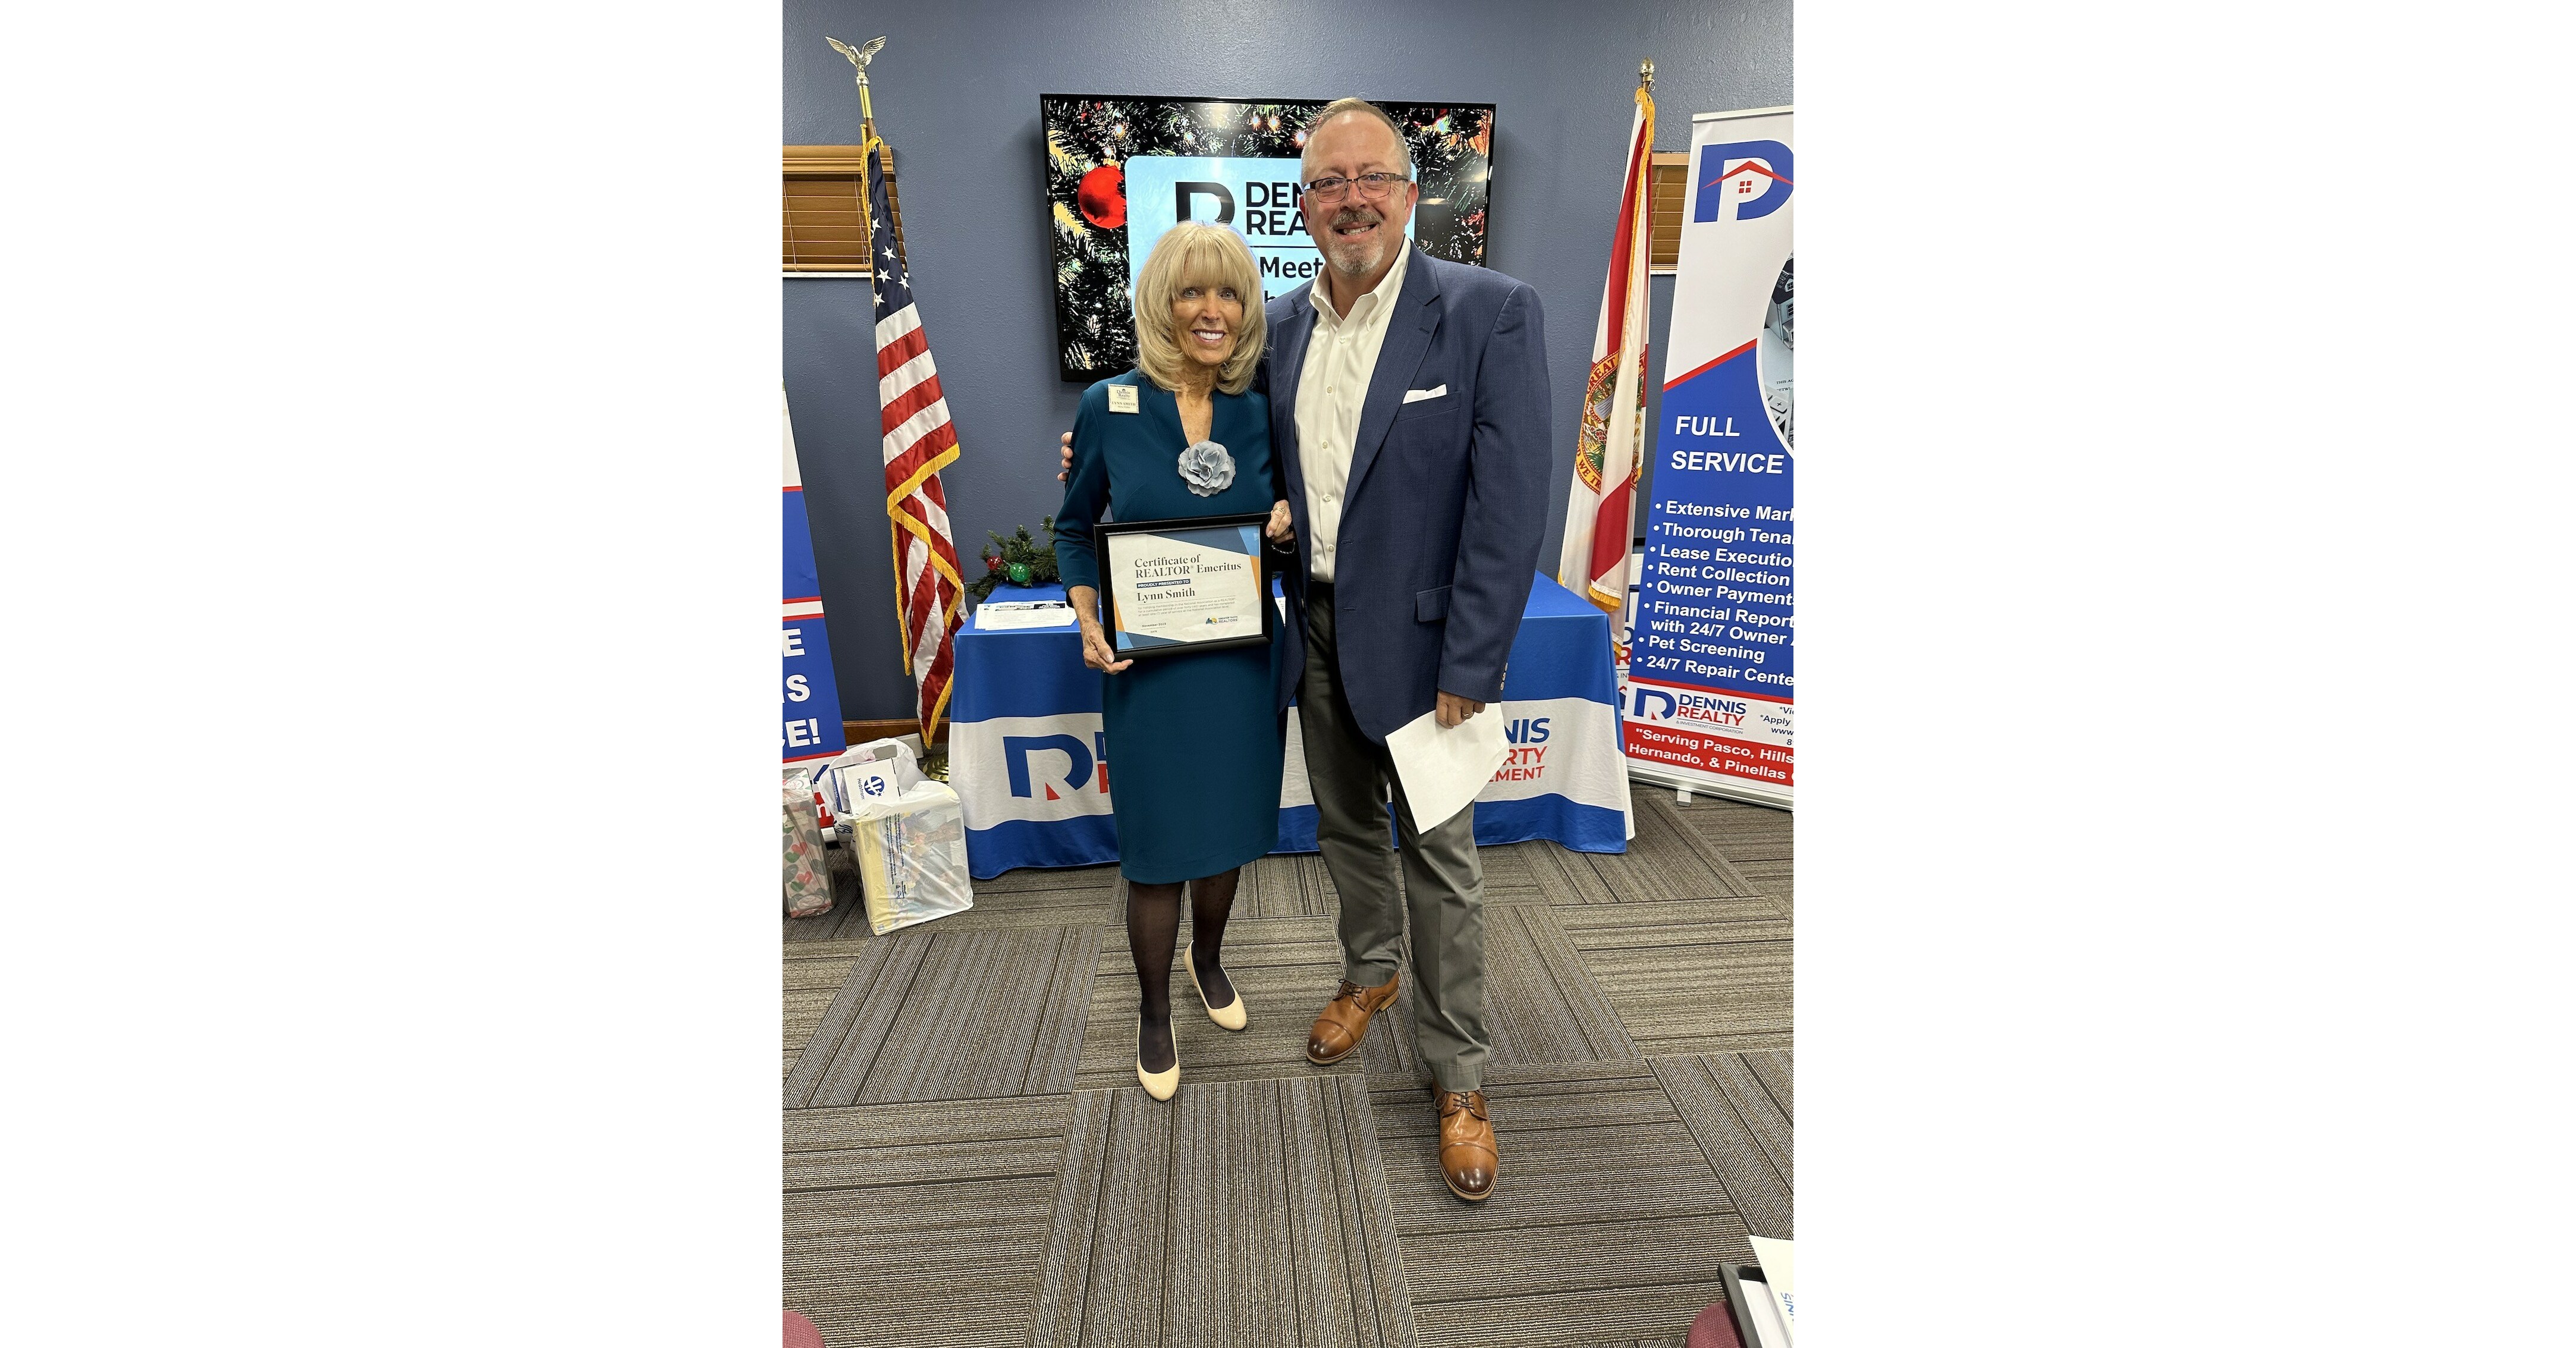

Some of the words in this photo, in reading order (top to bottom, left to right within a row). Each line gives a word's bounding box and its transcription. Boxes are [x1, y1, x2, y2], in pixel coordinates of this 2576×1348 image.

[1246, 210, 1311, 236] REA
[1260, 257, 1323, 278] Meet
[1675, 416, 1740, 436] FULL
[1578, 459, 1591, 476] WE
[1671, 450, 1785, 474] SERVICE
[1666, 500, 1750, 519] Extensive
[1663, 522, 1745, 543] Thorough
[1749, 528, 1793, 545] Tena
[1135, 558, 1189, 568] Certificate
[1190, 554, 1201, 563] of
[1660, 544, 1710, 561] Lease
[1716, 548, 1793, 567] Executio
[1196, 563, 1242, 573] Emeritus
[1658, 562, 1697, 578] Rent
[1701, 566, 1790, 586] Collection
[1137, 593, 1163, 603] Lynn
[1166, 587, 1196, 599] Smith
[1657, 580, 1712, 597] Owner
[1654, 601, 1730, 621] Financial
[1651, 620, 1685, 633] with
[1689, 623, 1724, 637] 24/7
[1729, 627, 1787, 646] Owner
[1648, 635, 1675, 650] Pet
[1679, 638, 1765, 664] Screening
[1647, 656, 1680, 670] 24/7
[1685, 659, 1740, 678] Repair
[1744, 667, 1793, 686] Cente
[783, 674, 811, 703] S
[1679, 694, 1746, 714] DENNIS
[1677, 706, 1745, 726] REALTY
[783, 718, 821, 748] E!
[1680, 721, 1708, 729] INVESTMENT
[1709, 726, 1743, 734] CORPORATION
[1635, 727, 1699, 750] "Serving
[1704, 739, 1754, 759] Pasco,
[1503, 746, 1547, 765] RTY
[1629, 743, 1704, 766] Hernando,
[1708, 757, 1720, 768] &
[1725, 759, 1786, 780] Pinellas
